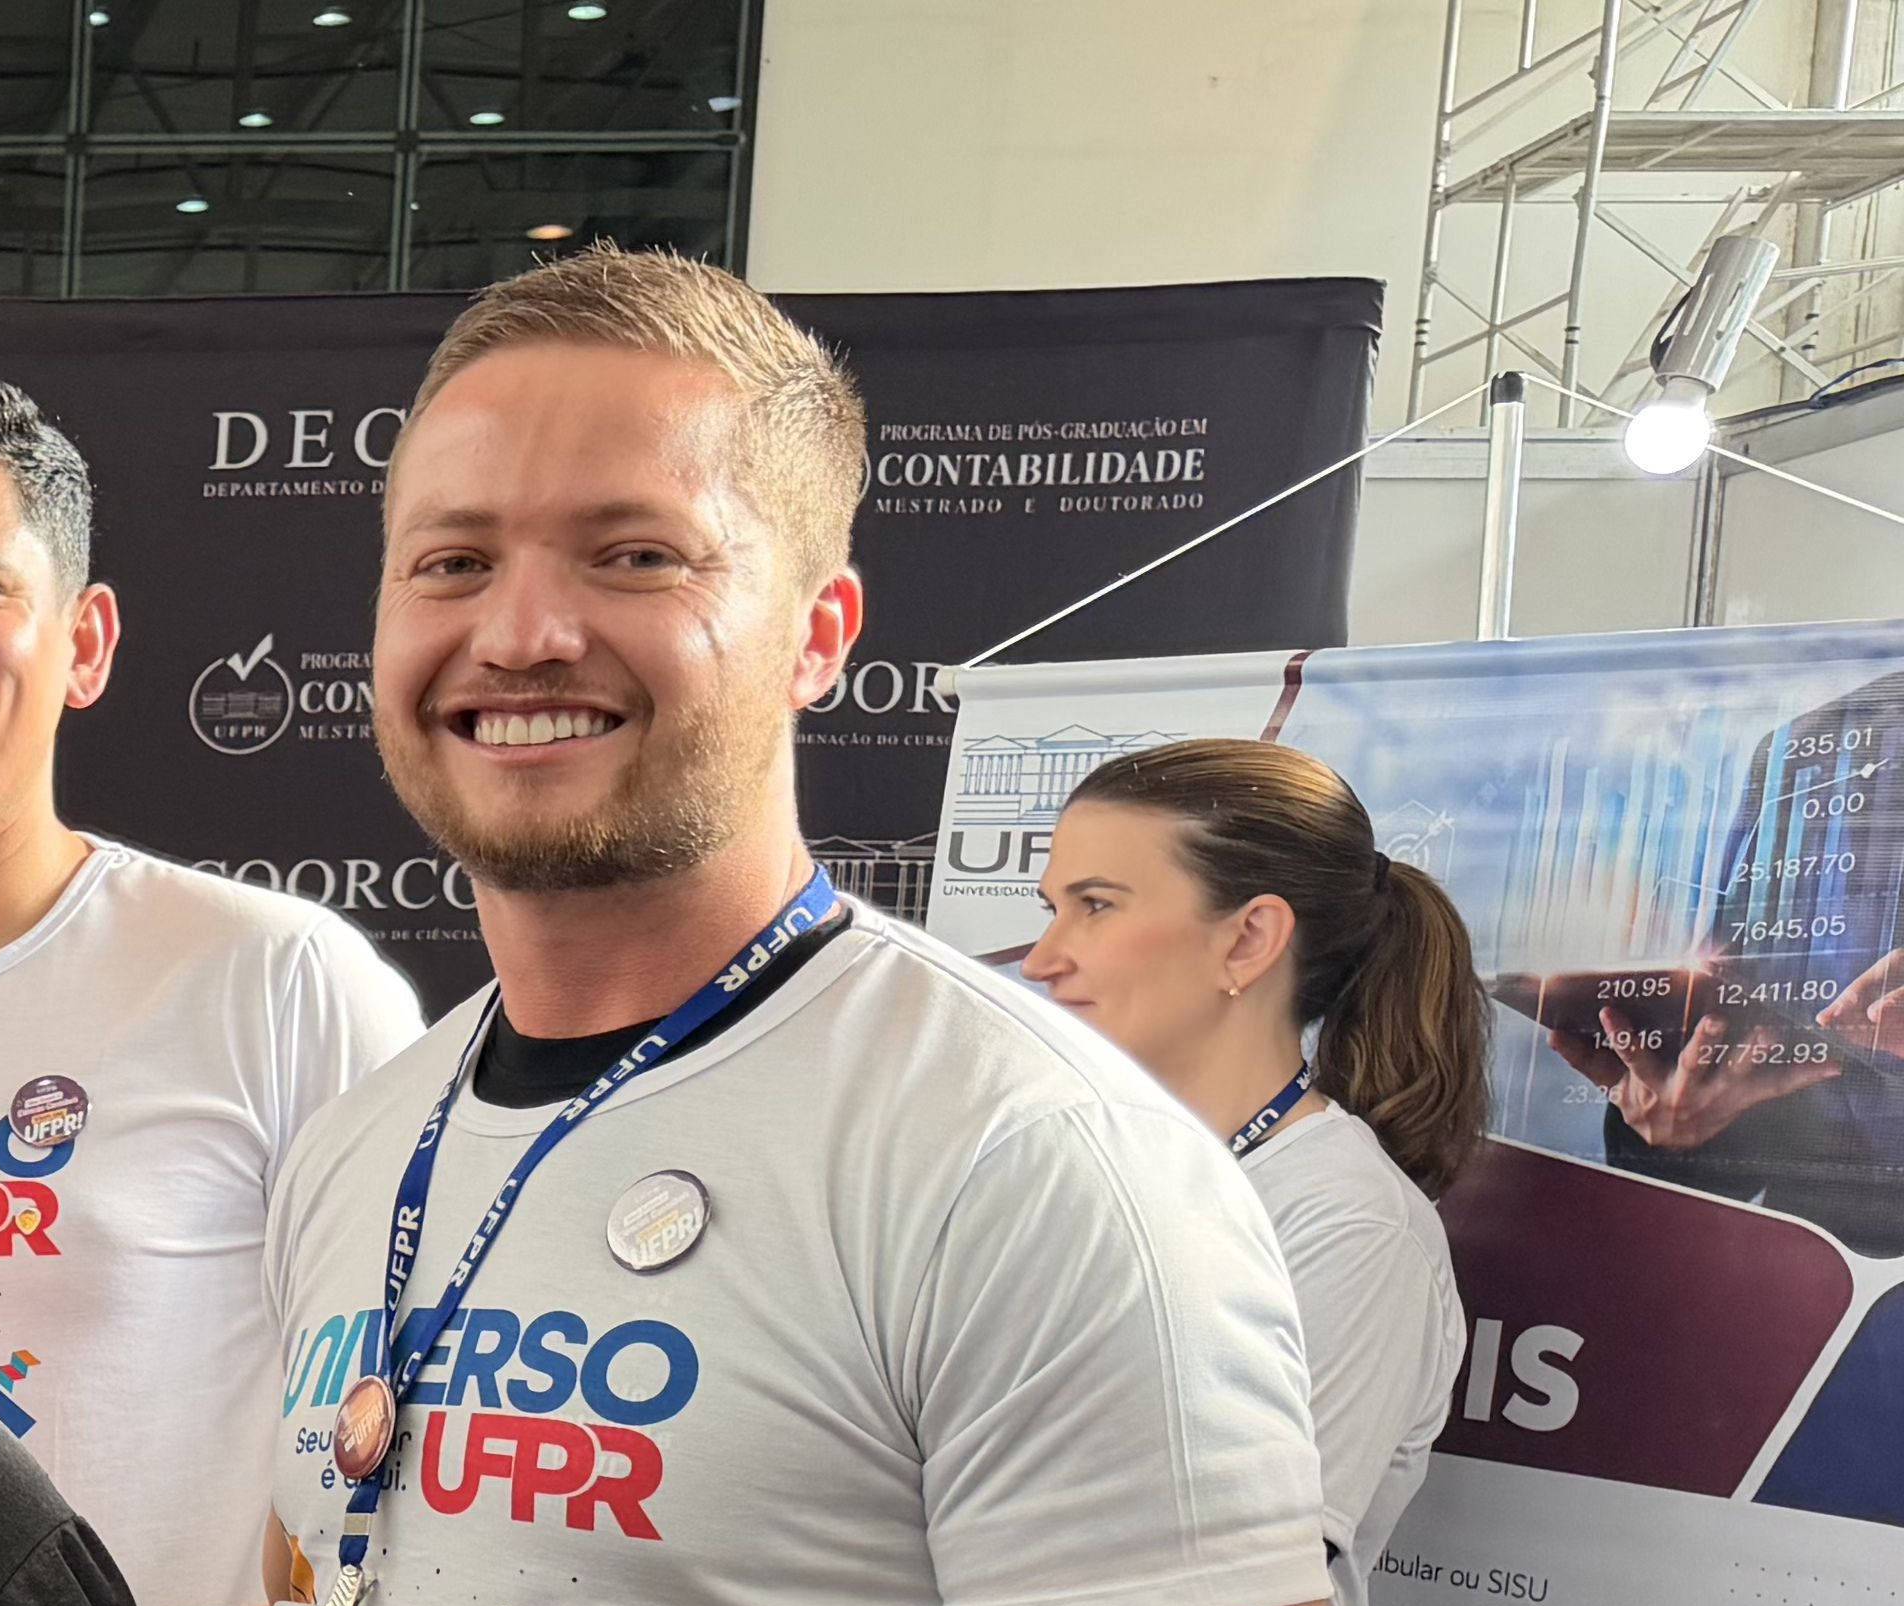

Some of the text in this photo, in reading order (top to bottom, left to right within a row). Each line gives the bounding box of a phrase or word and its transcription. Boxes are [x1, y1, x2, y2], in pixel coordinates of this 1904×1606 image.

[209, 407, 407, 471] DEC
[880, 416, 1208, 442] PROGRAMA DE PÓS-GRADUAÇÃO EM
[877, 447, 1206, 488] CONTABILIDADE
[203, 479, 364, 498] DEPARTAMENTO
[875, 493, 1204, 514] MESTRADO E DOUTORADO
[1782, 727, 1873, 760] 235.01
[1802, 792, 1865, 820] 0.00
[944, 884, 1036, 898] UNIVERSIDADE
[415, 927, 482, 940] CIÊNCIA
[715, 906, 815, 993] UFPR
[1597, 977, 1838, 1006] 210.95 12,411.80
[560, 1034, 668, 1122] UFPR
[23, 1111, 84, 1144] UFPR!
[1232, 1107, 1280, 1153] UFP
[449, 1178, 519, 1289] UFPR
[387, 1204, 422, 1312] UFPR
[1463, 1317, 1585, 1432] IS
[295, 1427, 333, 1454] Seu
[320, 1459, 336, 1490] é
[420, 1411, 664, 1541] UFPR
[1450, 1568, 1480, 1592] ou
[1487, 1567, 1549, 1603] SISU
